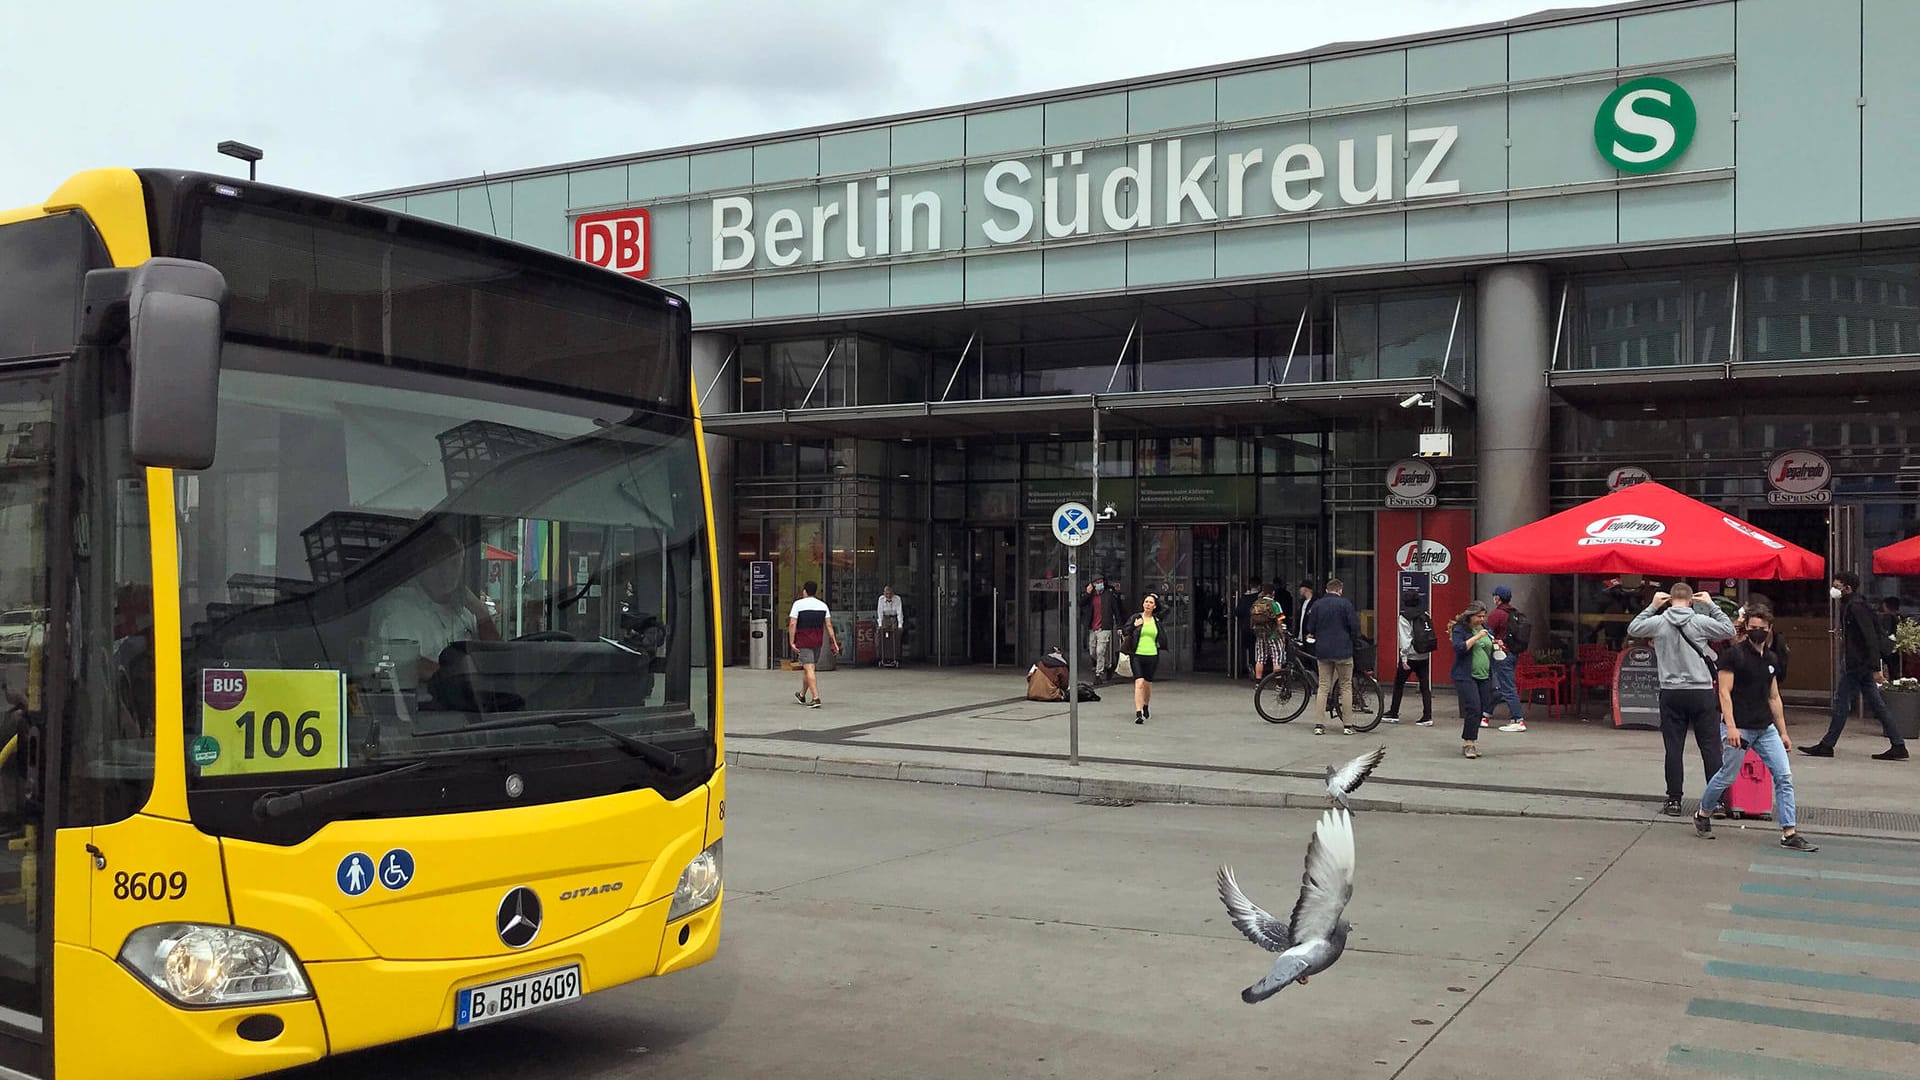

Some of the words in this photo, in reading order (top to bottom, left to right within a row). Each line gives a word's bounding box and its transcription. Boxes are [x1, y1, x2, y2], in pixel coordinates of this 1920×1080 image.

[1612, 88, 1676, 163] S
[712, 176, 941, 272] Berlin
[981, 124, 1460, 243] Südkreuz
[585, 220, 641, 269] DB
[1391, 467, 1431, 487] Segafredo
[1775, 459, 1825, 482] Segafredo
[1389, 497, 1433, 505] ESPRESSO
[1774, 492, 1827, 502] ESPRESSO
[1591, 518, 1660, 535] Segafredo
[1585, 538, 1654, 546] ESPRESSO
[1401, 544, 1447, 567] Seafredo
[213, 678, 244, 693] BUS
[235, 710, 322, 760] 106
[113, 871, 188, 901] 8609
[559, 881, 624, 901] CITARO
[472, 991, 486, 1018] B
[500, 982, 527, 1012] BH
[531, 972, 577, 1005] 8609
